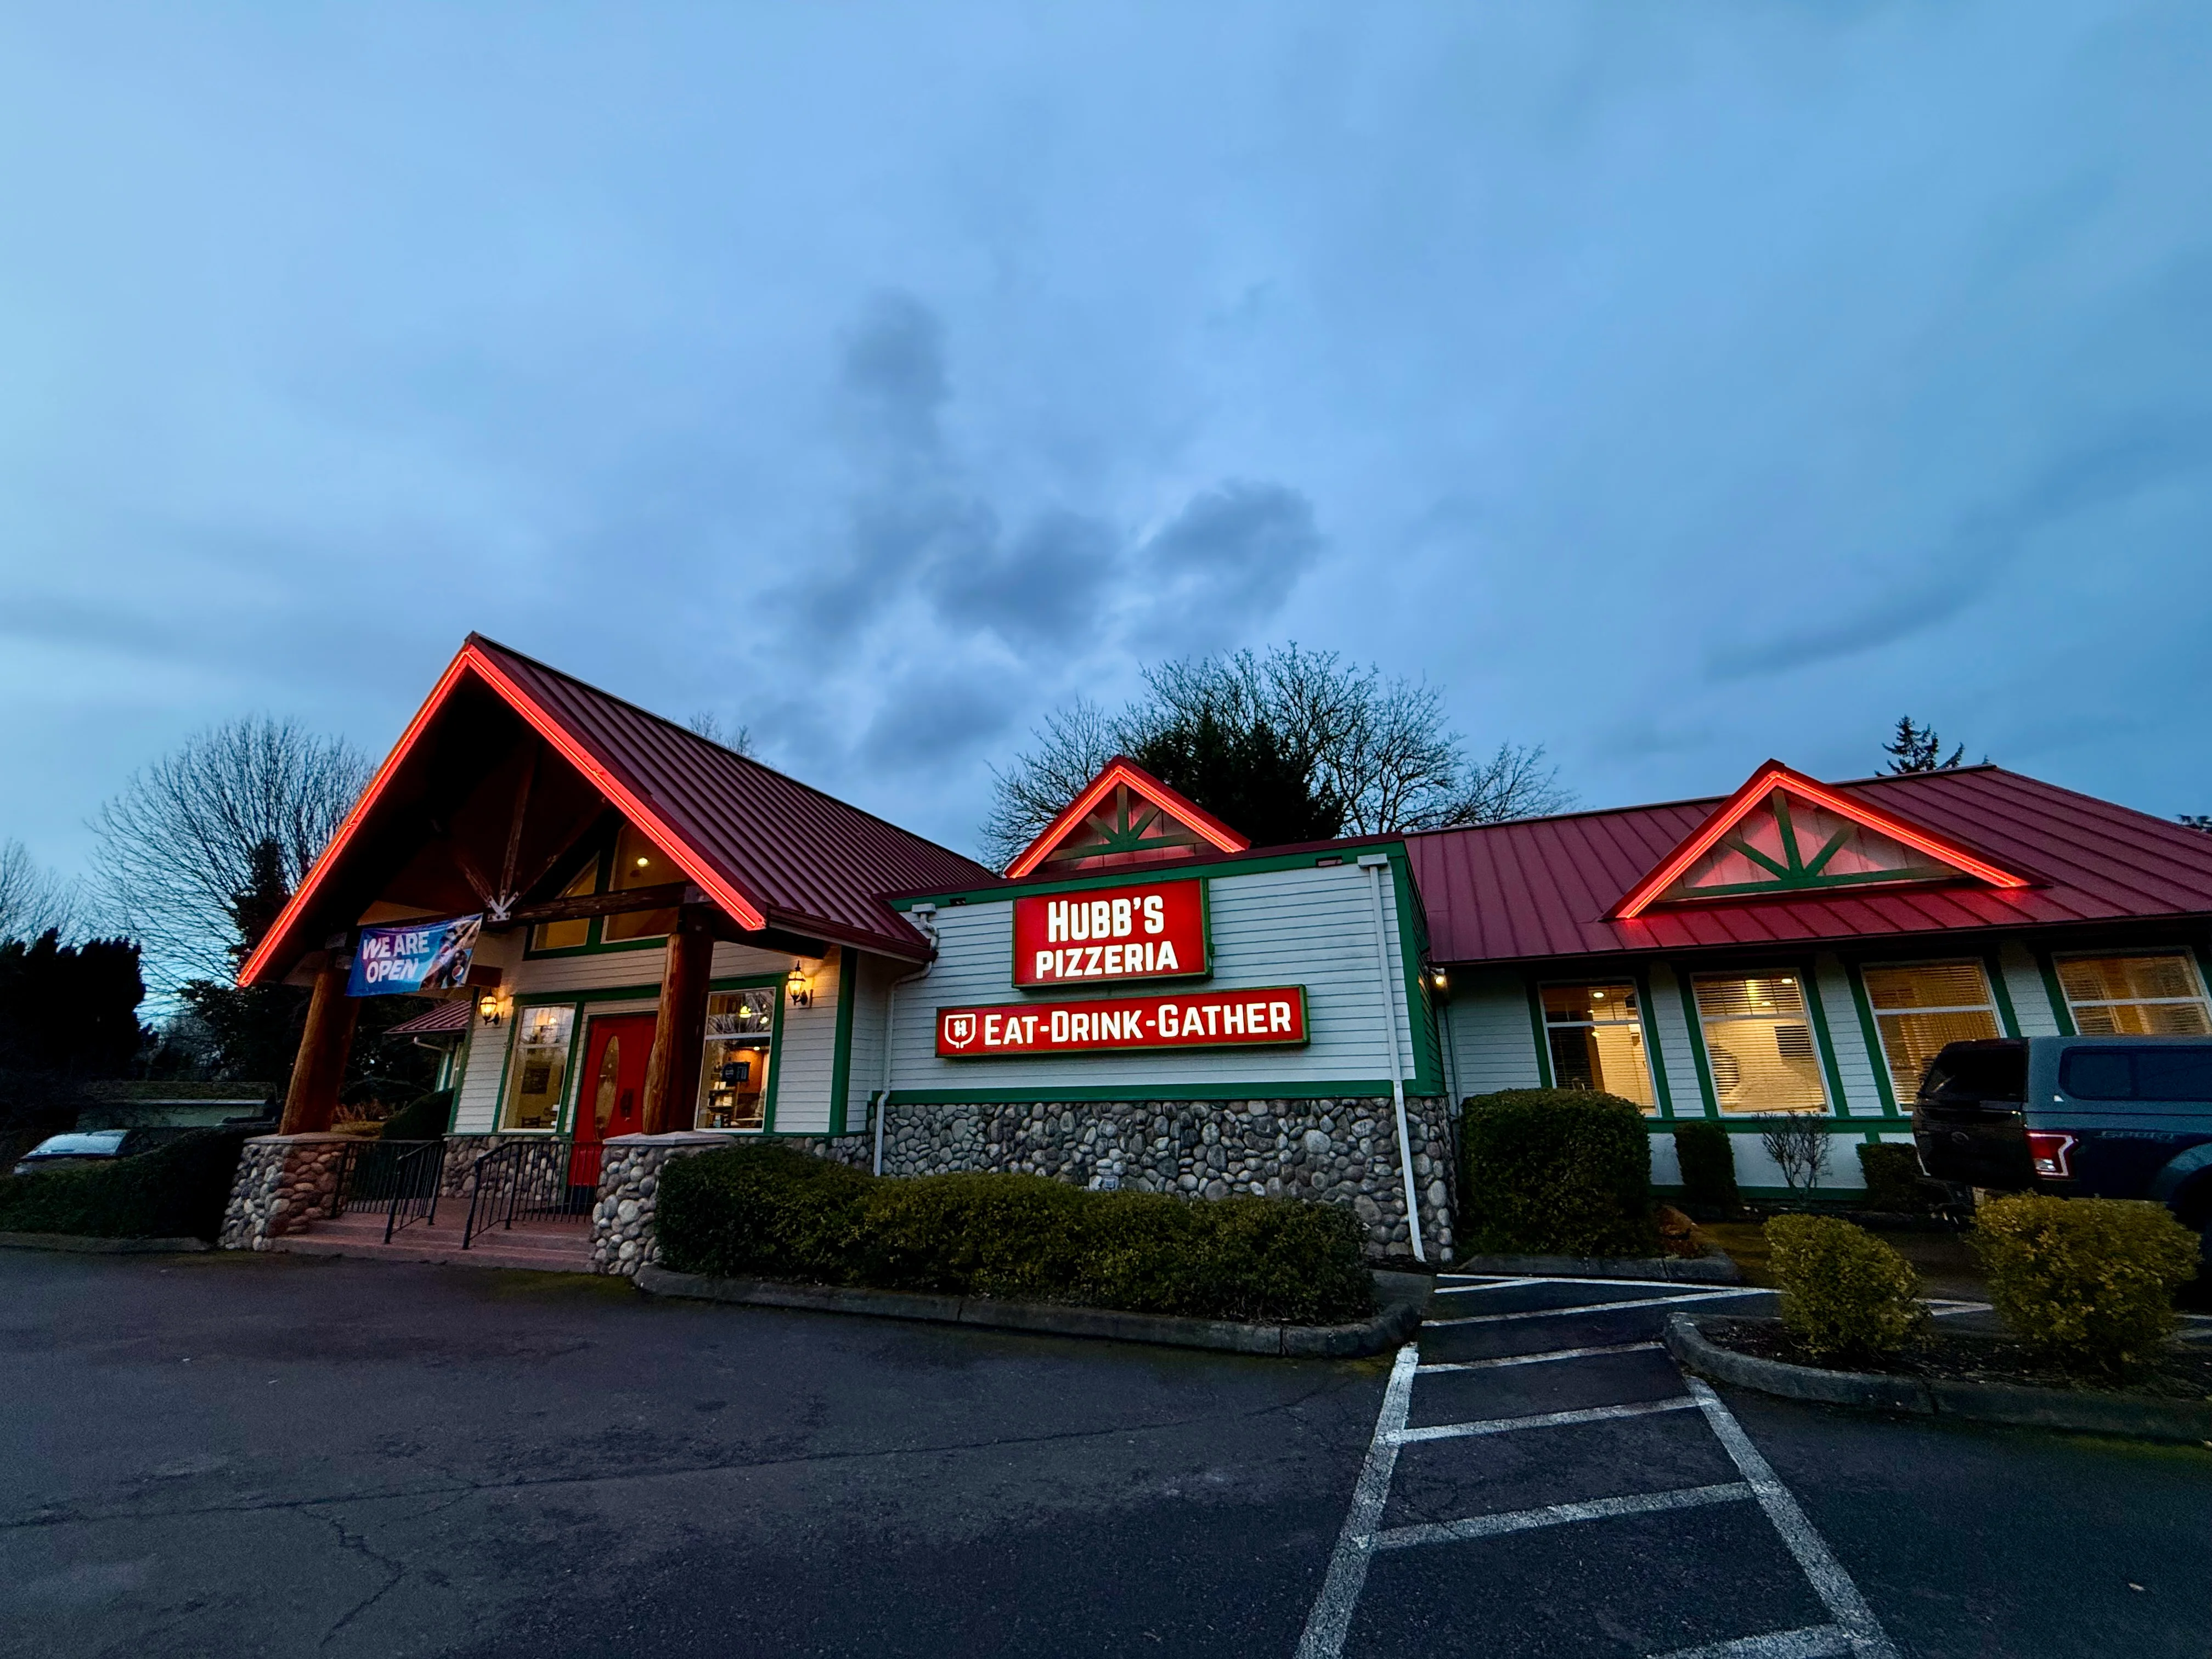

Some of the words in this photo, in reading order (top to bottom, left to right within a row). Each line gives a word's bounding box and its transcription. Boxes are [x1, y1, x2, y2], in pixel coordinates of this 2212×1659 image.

[1047, 894, 1165, 943] HUBB'S
[363, 936, 391, 960] WE
[393, 931, 430, 956] ARE
[1035, 940, 1179, 980] PIZZERIA
[366, 957, 419, 983] OPEN
